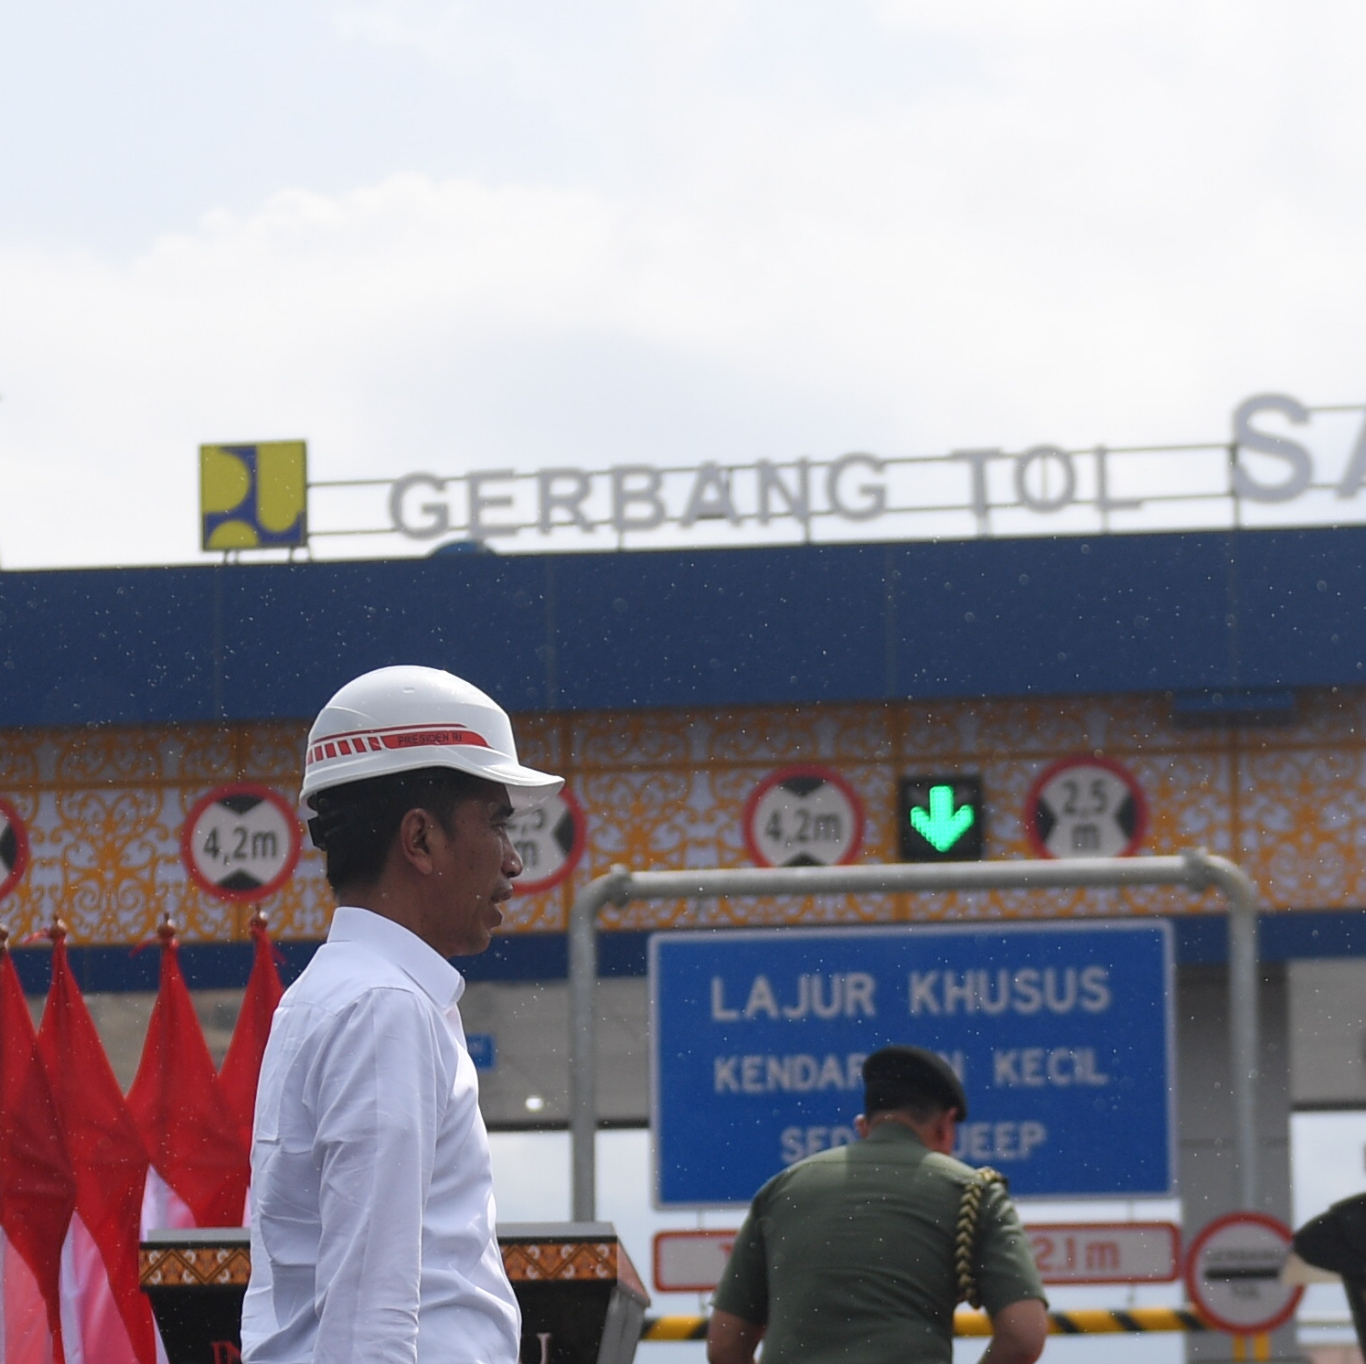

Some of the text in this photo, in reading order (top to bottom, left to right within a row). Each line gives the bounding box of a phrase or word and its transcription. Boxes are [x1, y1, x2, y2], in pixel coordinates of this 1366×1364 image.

[387, 450, 889, 544] GERBANG
[953, 442, 1143, 516] TOL
[711, 965, 1113, 1022] LAJUR KHUSUS
[994, 1046, 1110, 1088] KECIL
